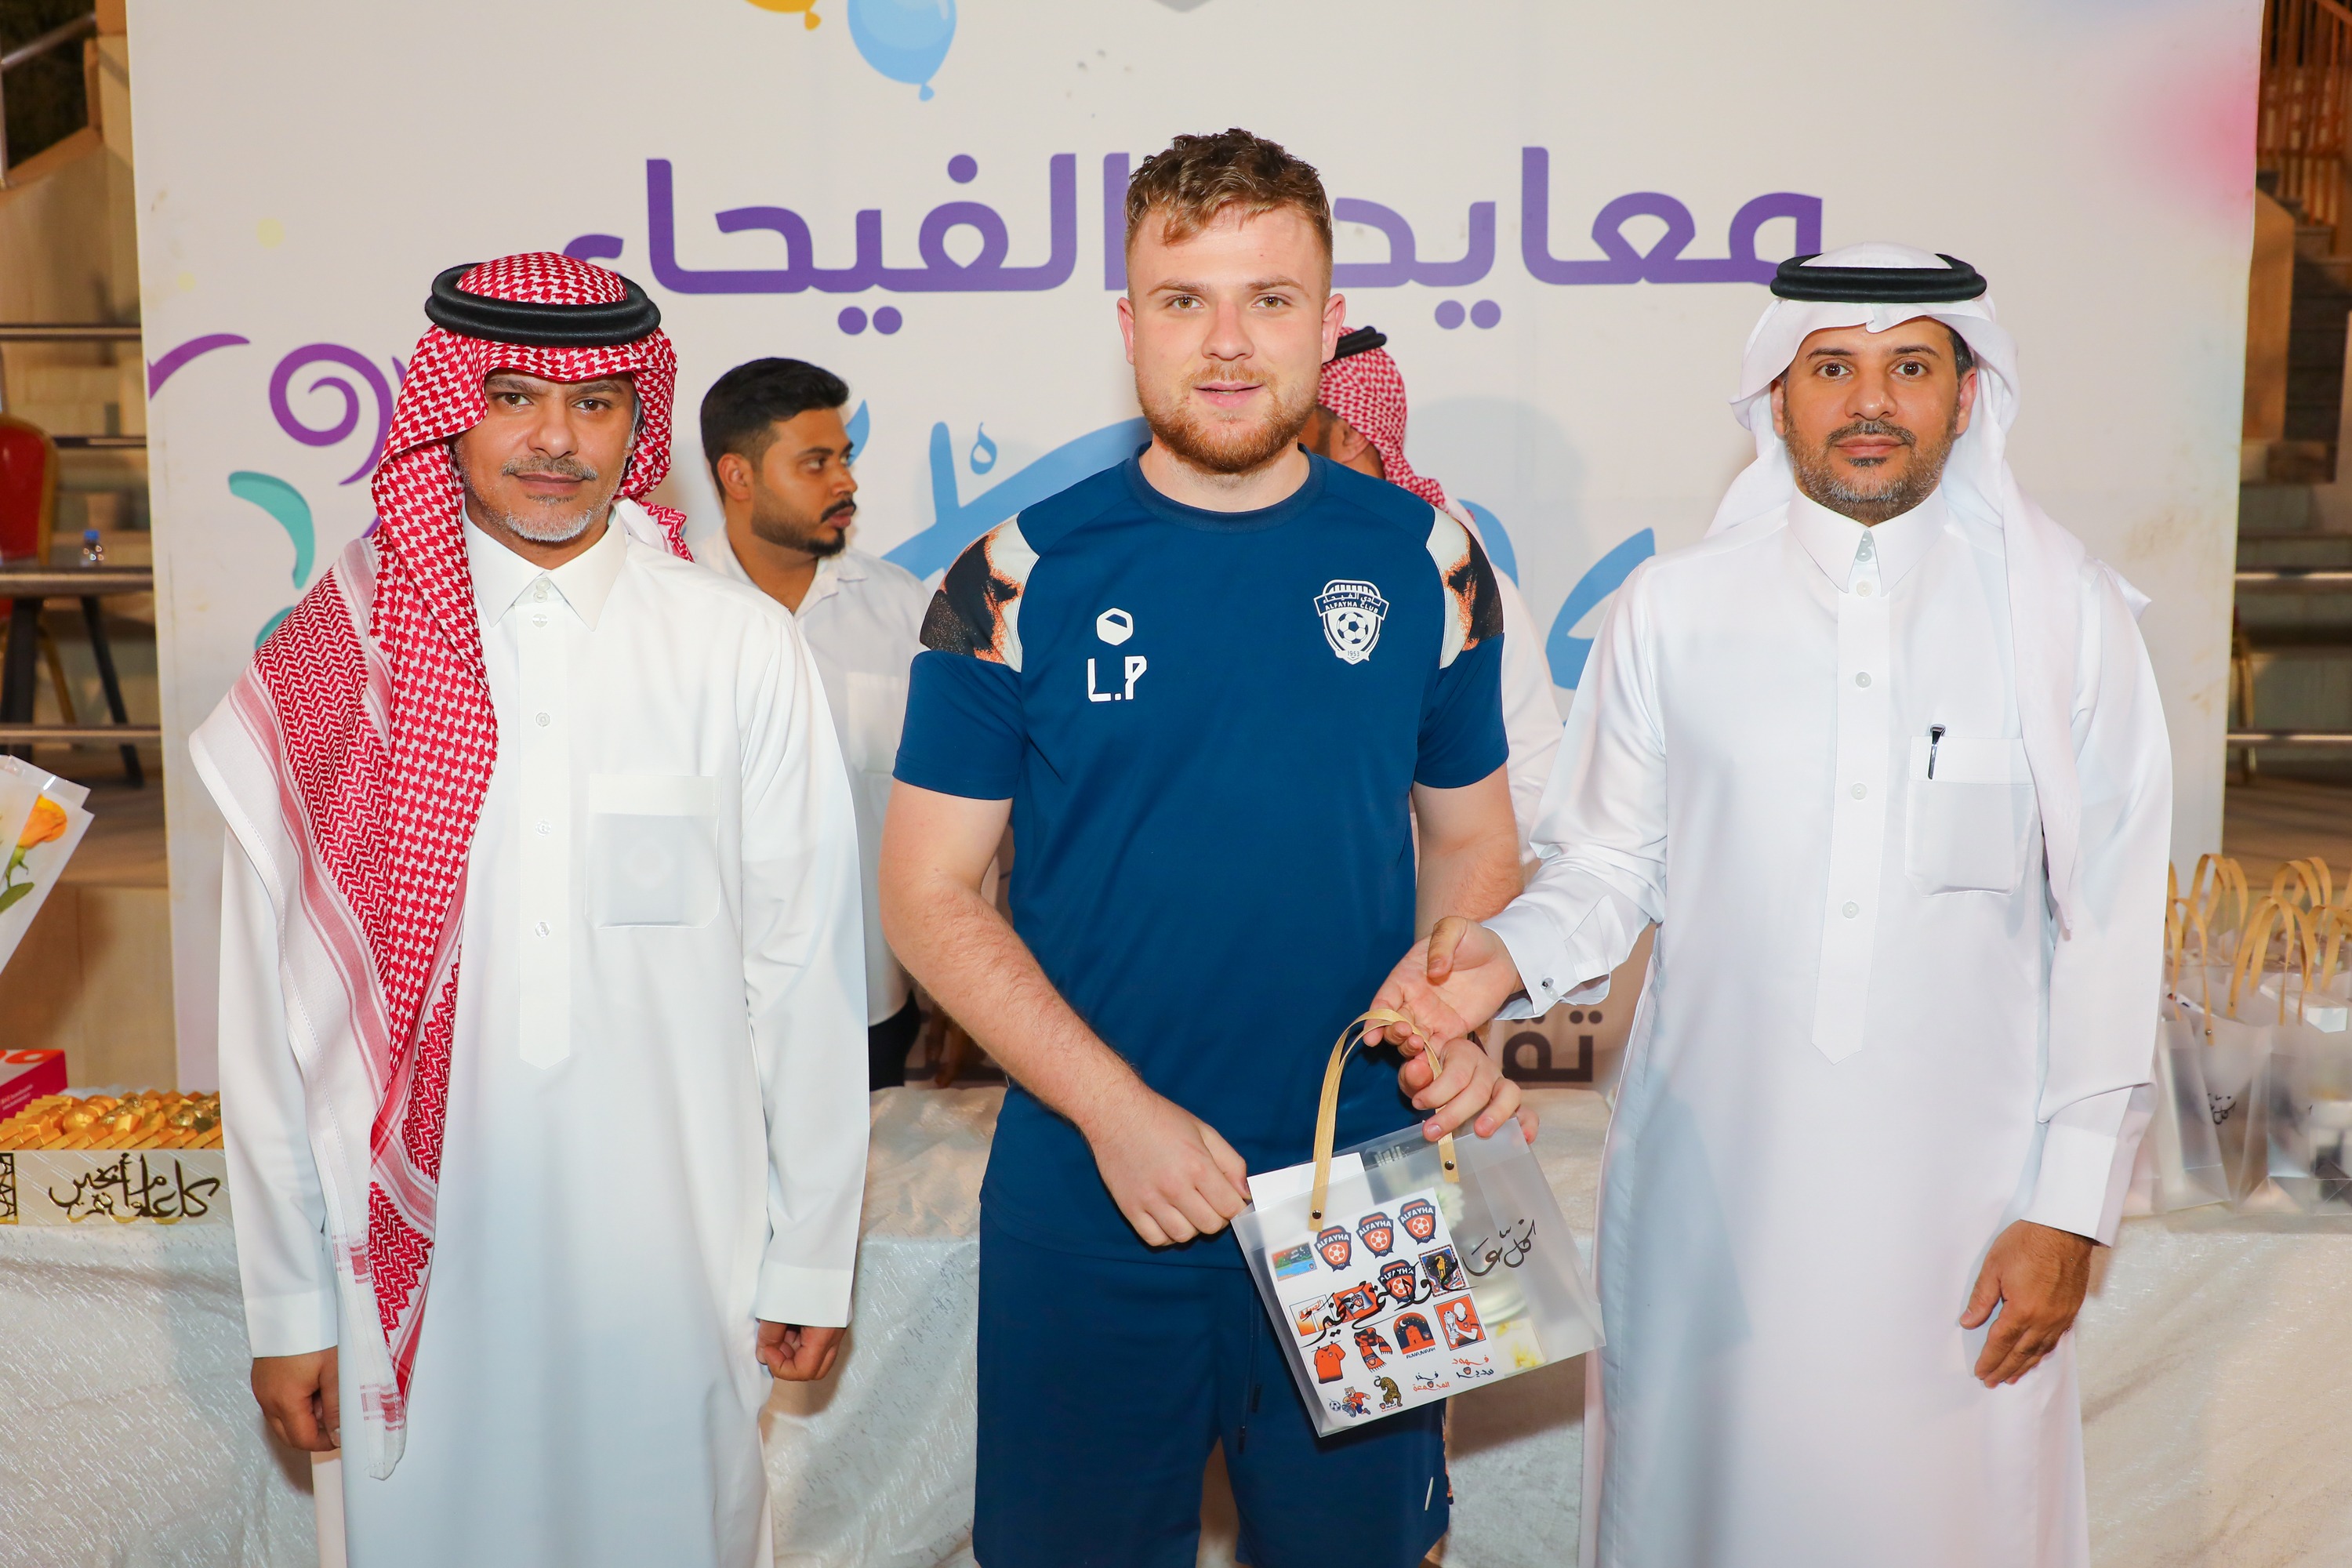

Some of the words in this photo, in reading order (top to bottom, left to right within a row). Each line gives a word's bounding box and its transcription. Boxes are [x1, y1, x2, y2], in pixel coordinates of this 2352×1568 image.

[1332, 147, 1823, 329] معايد
[1323, 593, 1359, 604] الفيحاء
[1360, 595, 1382, 607] نادي
[1325, 601, 1358, 611] ALFAYHA
[1360, 603, 1379, 614] CLUB
[1087, 655, 1148, 702] L.P
[1400, 1207, 1434, 1223] ALFAYHA
[1359, 1220, 1392, 1237] ALFAYHA
[1316, 1233, 1350, 1250] ALFAYHA
